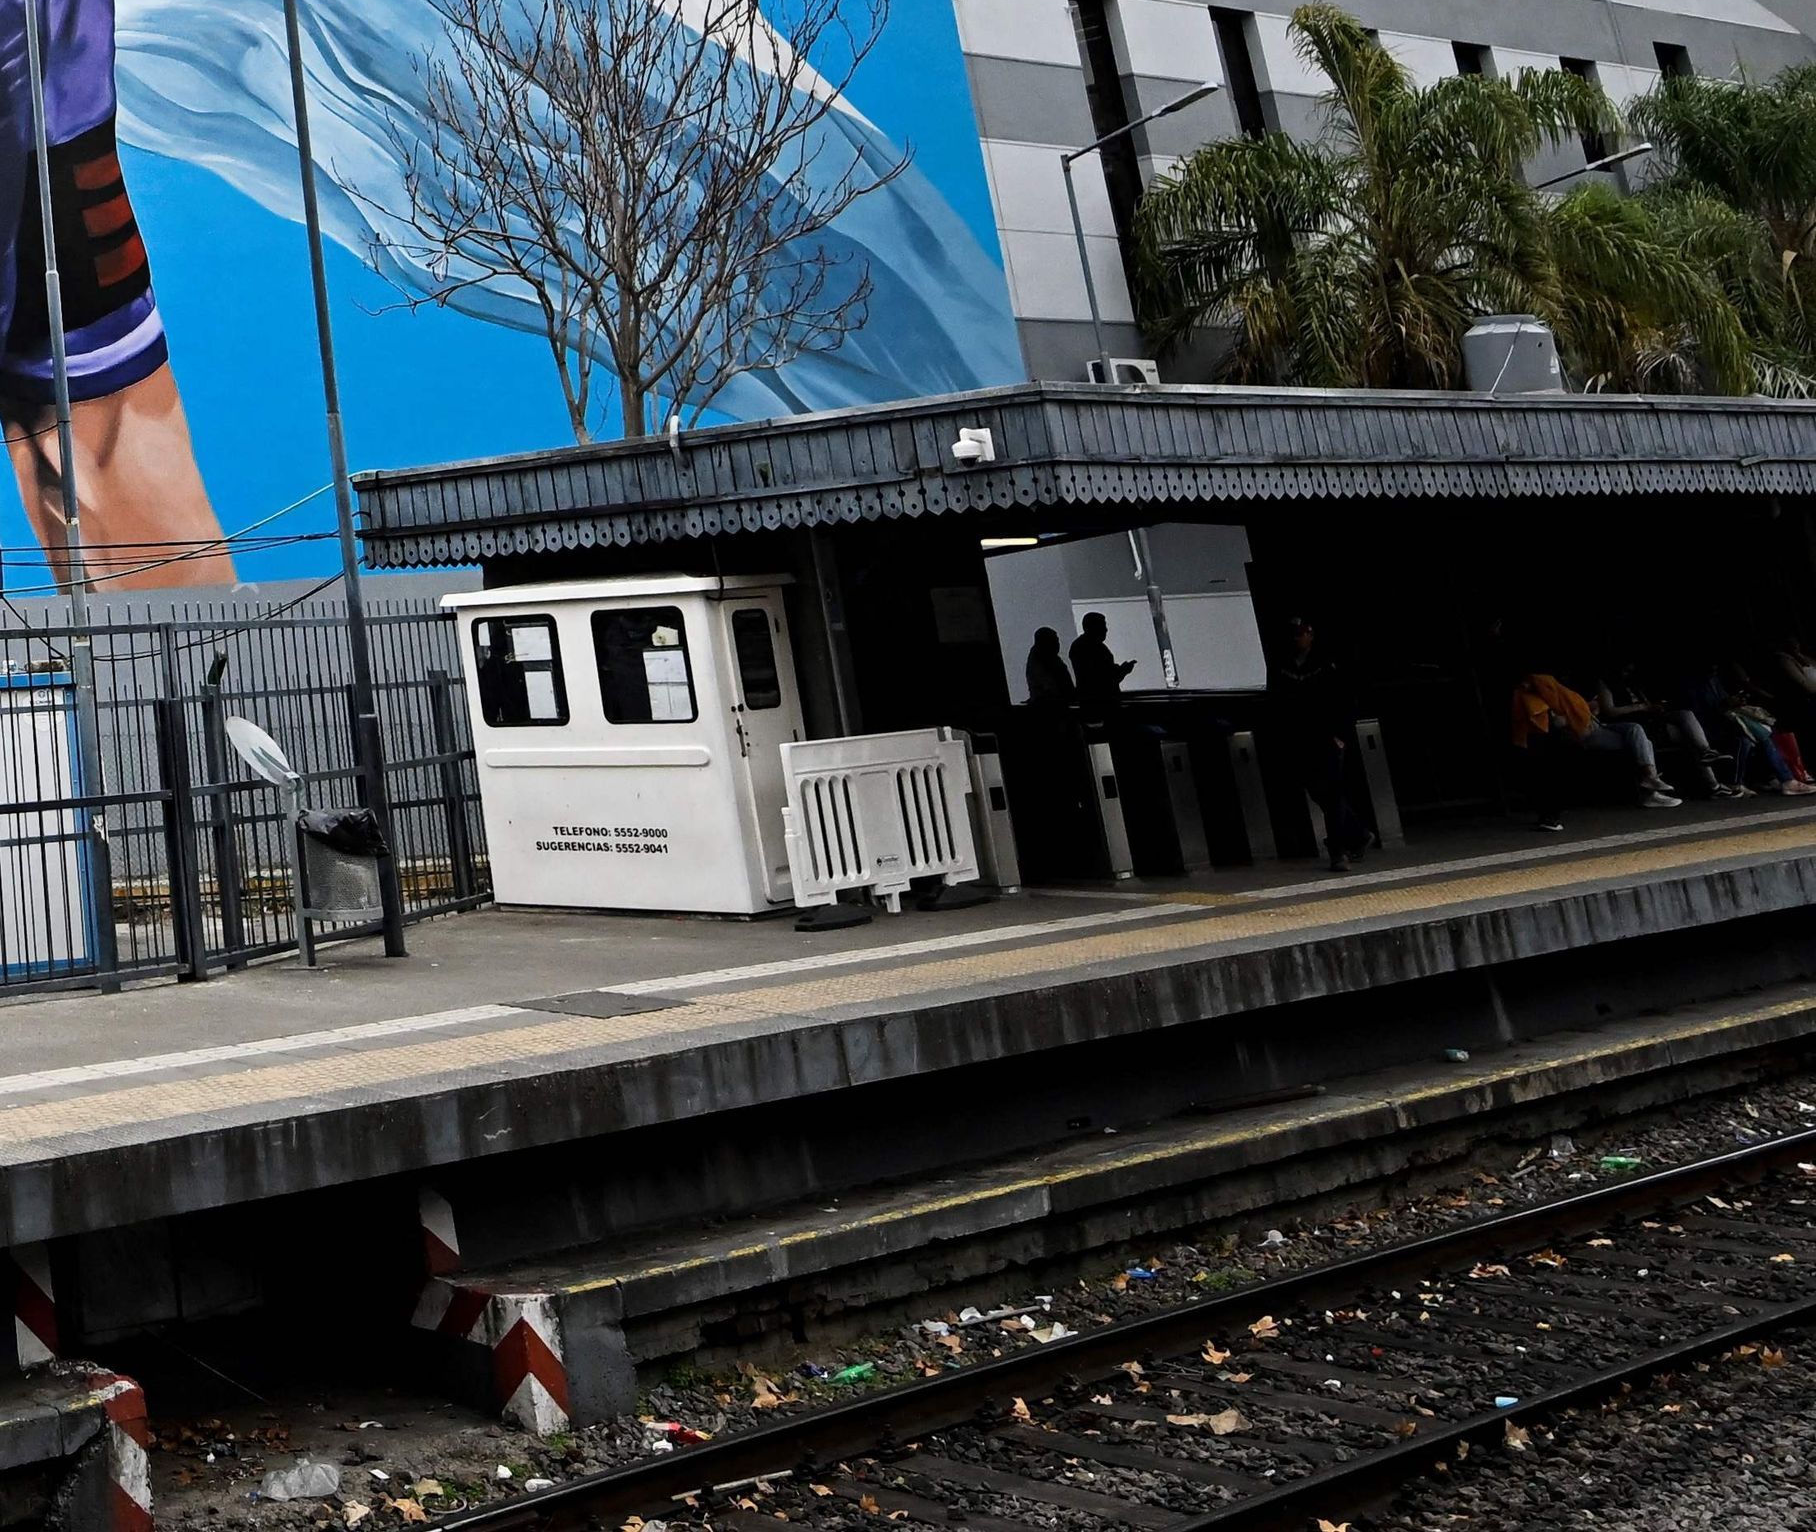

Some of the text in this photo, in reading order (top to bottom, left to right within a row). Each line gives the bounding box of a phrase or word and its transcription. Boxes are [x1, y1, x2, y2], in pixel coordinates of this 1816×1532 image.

[552, 826, 668, 838] TELEFONO: 5552-9000
[536, 841, 669, 854] SUGERENCIAS: 5552-9041
